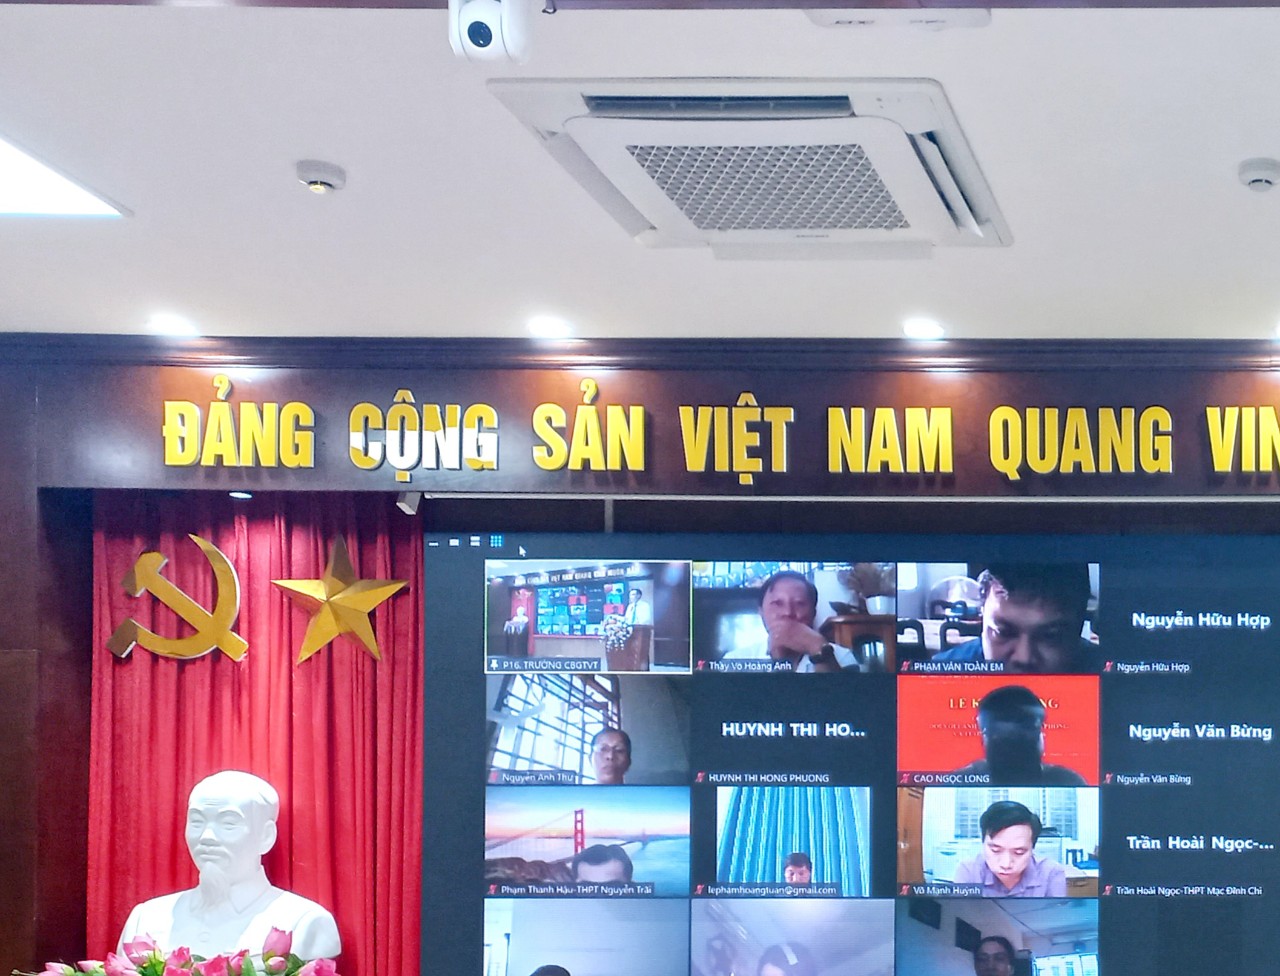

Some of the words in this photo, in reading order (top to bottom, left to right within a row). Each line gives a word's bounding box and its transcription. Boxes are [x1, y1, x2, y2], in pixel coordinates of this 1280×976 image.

[162, 374, 315, 469] ĐẢNG
[349, 389, 499, 483] CỘNG
[531, 376, 646, 472] SẢN
[678, 392, 794, 485] VIỆT
[828, 406, 954, 474] NAM
[989, 405, 1173, 481] QUANG
[1132, 610, 1193, 630] Nguyễn
[1198, 612, 1232, 627] Hữu
[1237, 612, 1271, 630] Hợp
[990, 663, 1004, 671] EM
[721, 722, 783, 737] HUYNH
[789, 722, 818, 737] THI
[825, 722, 866, 737] HO...
[1129, 721, 1190, 741] Nguyễn
[1194, 723, 1225, 738] Văn
[1230, 723, 1273, 741] Bừng
[708, 774, 742, 783] HUYNH
[743, 774, 759, 783] THI
[759, 774, 788, 783] HONG
[789, 774, 830, 783] PHUONG
[913, 774, 934, 783] CAO
[935, 774, 963, 785] NGỌC
[964, 774, 990, 783] LONG
[1126, 834, 1161, 850] Trần
[1168, 835, 1205, 850] Hoài
[527, 885, 555, 894] Thanh
[1247, 887, 1263, 895] Chi
